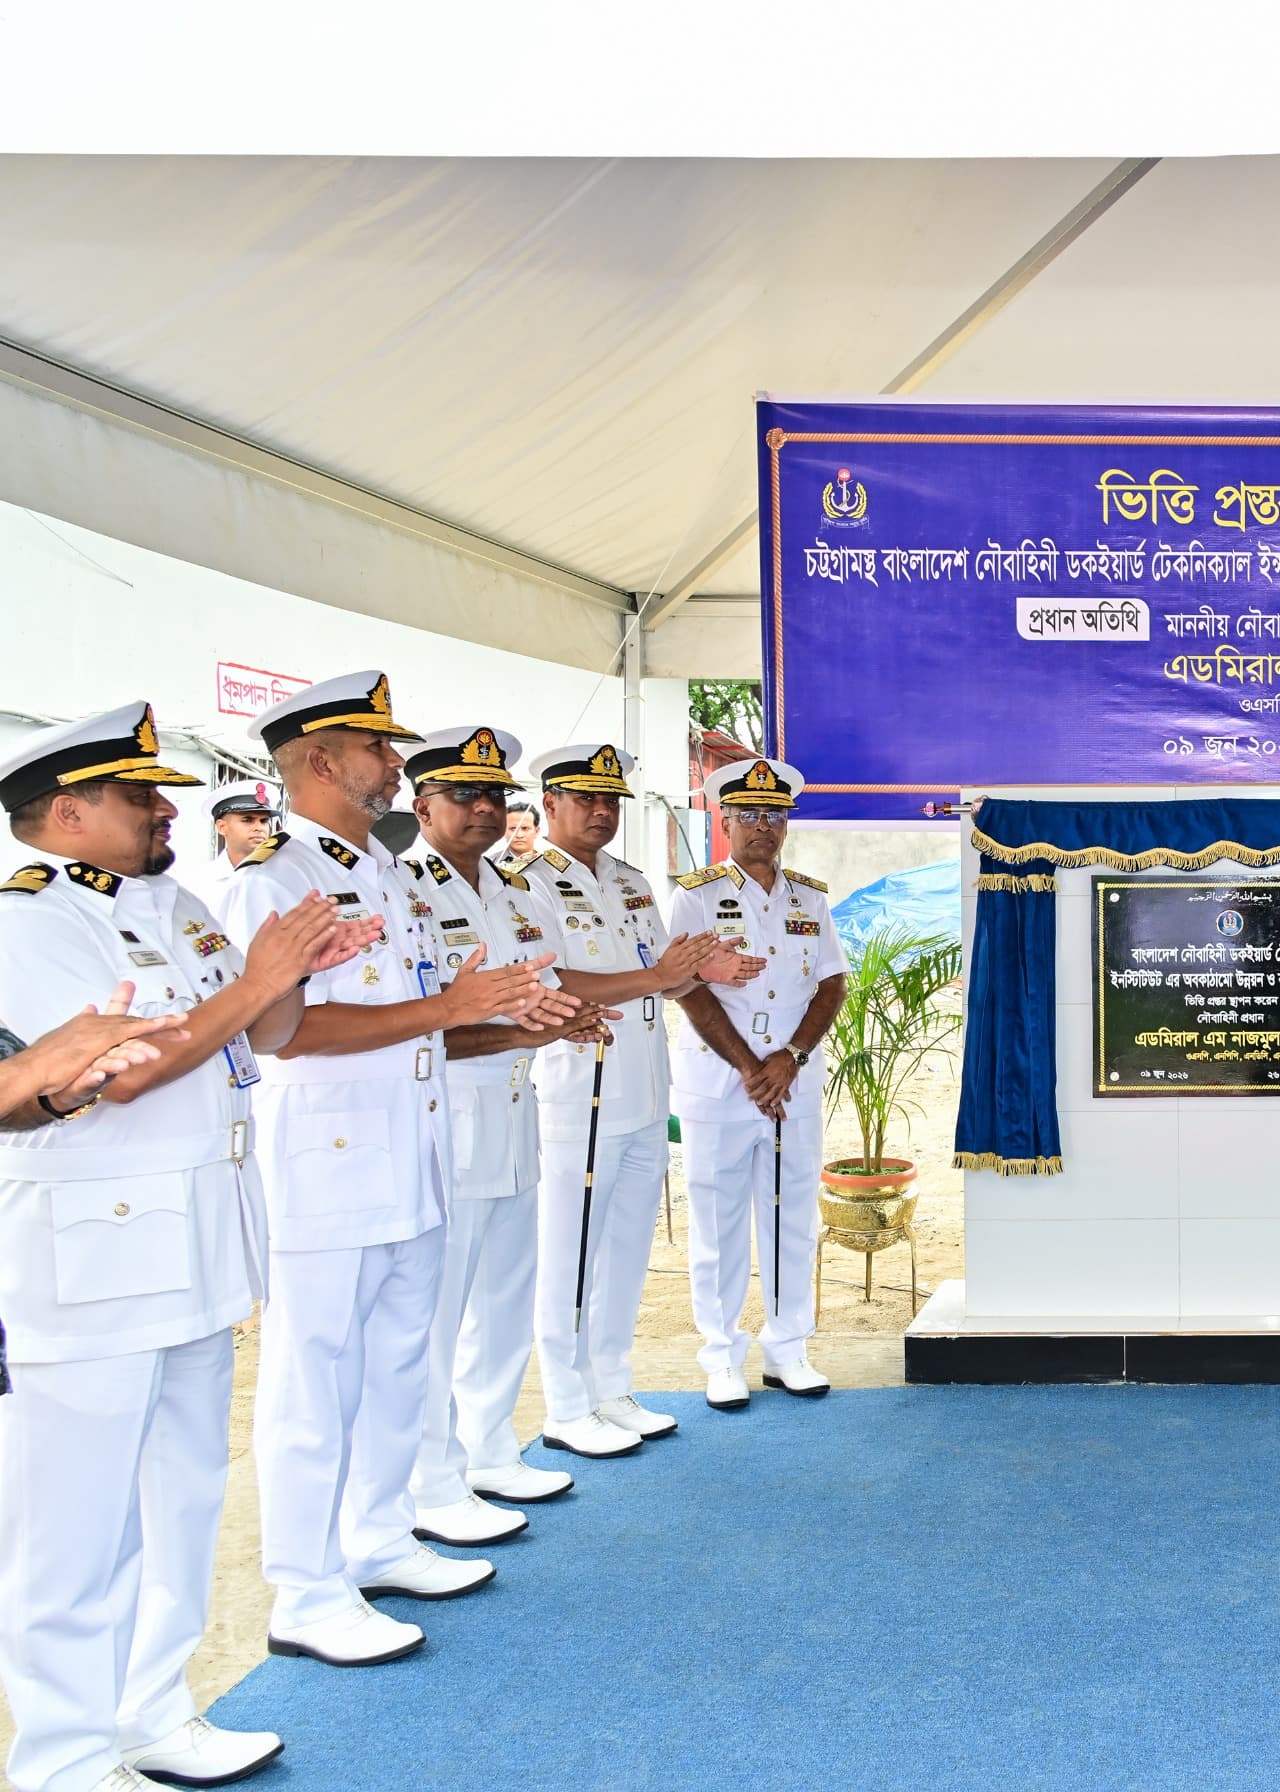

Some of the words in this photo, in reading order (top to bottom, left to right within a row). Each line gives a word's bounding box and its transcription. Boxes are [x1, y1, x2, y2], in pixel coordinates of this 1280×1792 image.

[1095, 468, 1200, 525] ভিত্তি
[803, 536, 879, 588] চট্টগ্রামস্থ
[880, 546, 970, 583] বাংলাদেশ
[975, 537, 1061, 583] নৌবাহিনী
[1064, 538, 1147, 583] ডকইয়ার্ড
[1151, 538, 1253, 583] টেকনিক্যাল
[1028, 607, 1077, 636] প্রধান
[1080, 601, 1141, 633] অতিথি
[1163, 605, 1231, 638] মাননীয়
[222, 675, 268, 711] ধূমপান
[1163, 737, 1195, 758] ০৯
[1200, 734, 1241, 762] জুন
[1130, 946, 1179, 964] বাংলাদেশ
[1180, 942, 1227, 964] নৌবাহিনী
[1228, 942, 1274, 963] ডকইয়ার্ড
[1165, 973, 1181, 988] এর
[1182, 968, 1234, 988] অবকাঠামো
[1234, 969, 1265, 990] উন্নয়ন
[1266, 973, 1276, 986] ও
[1184, 994, 1206, 1007] ভিত্তি
[1206, 996, 1227, 1007] প্রস্তর
[1227, 996, 1252, 1009] স্থাপন
[1252, 996, 1279, 1006] করেন
[1196, 1010, 1239, 1024] নৌবাহিনী
[1240, 1013, 1265, 1024] প্রধান
[1134, 1026, 1199, 1048] এডমিরাল
[1203, 1031, 1227, 1047] এম
